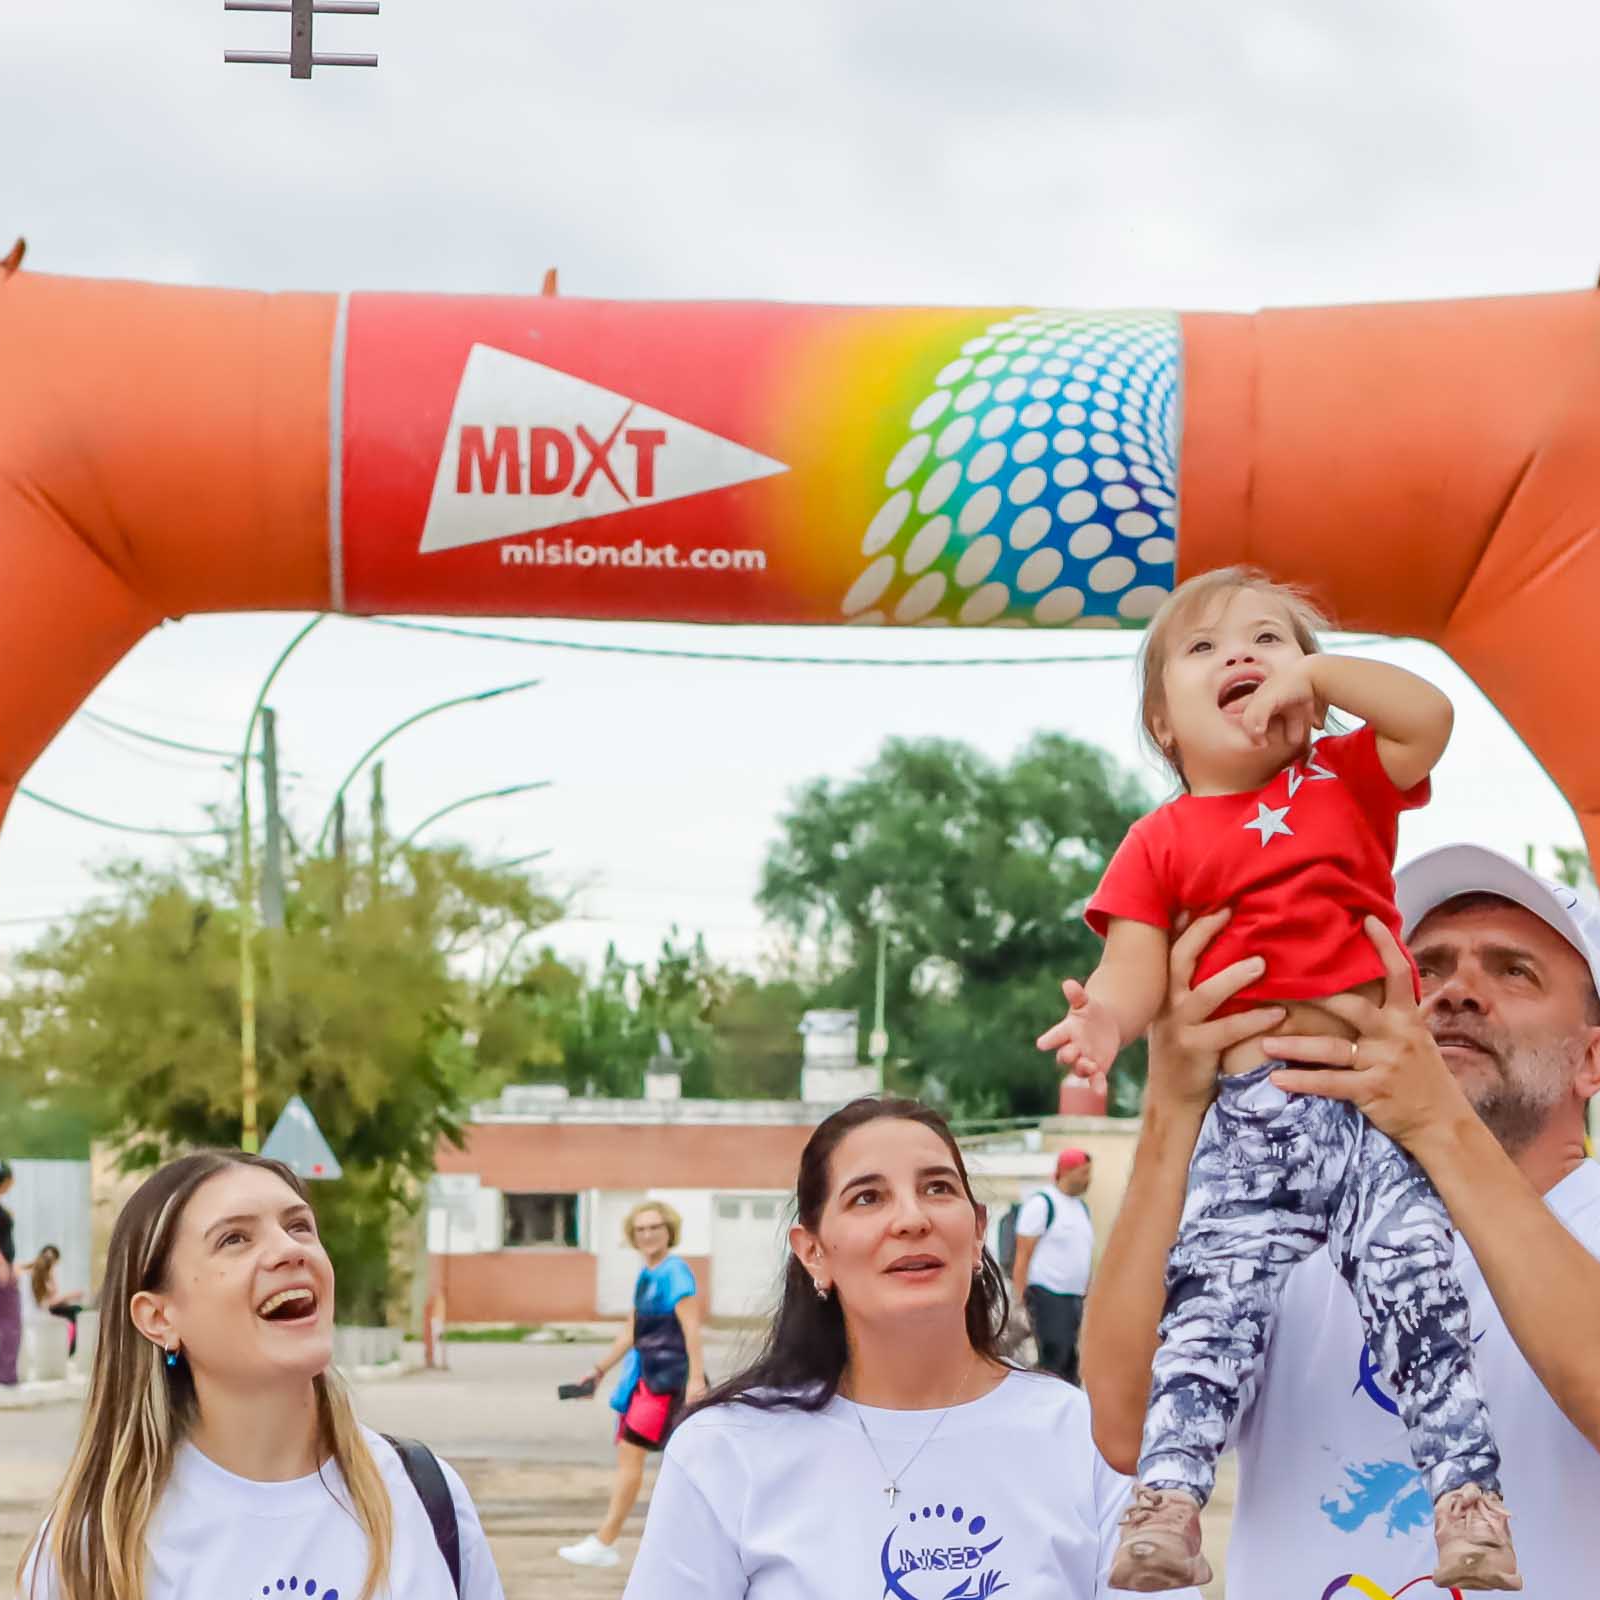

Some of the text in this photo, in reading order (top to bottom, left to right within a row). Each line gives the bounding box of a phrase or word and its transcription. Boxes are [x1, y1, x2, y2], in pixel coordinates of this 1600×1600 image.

[456, 401, 666, 505] MDXT
[501, 537, 767, 570] misiondxt.com
[899, 1546, 983, 1571] INISED
